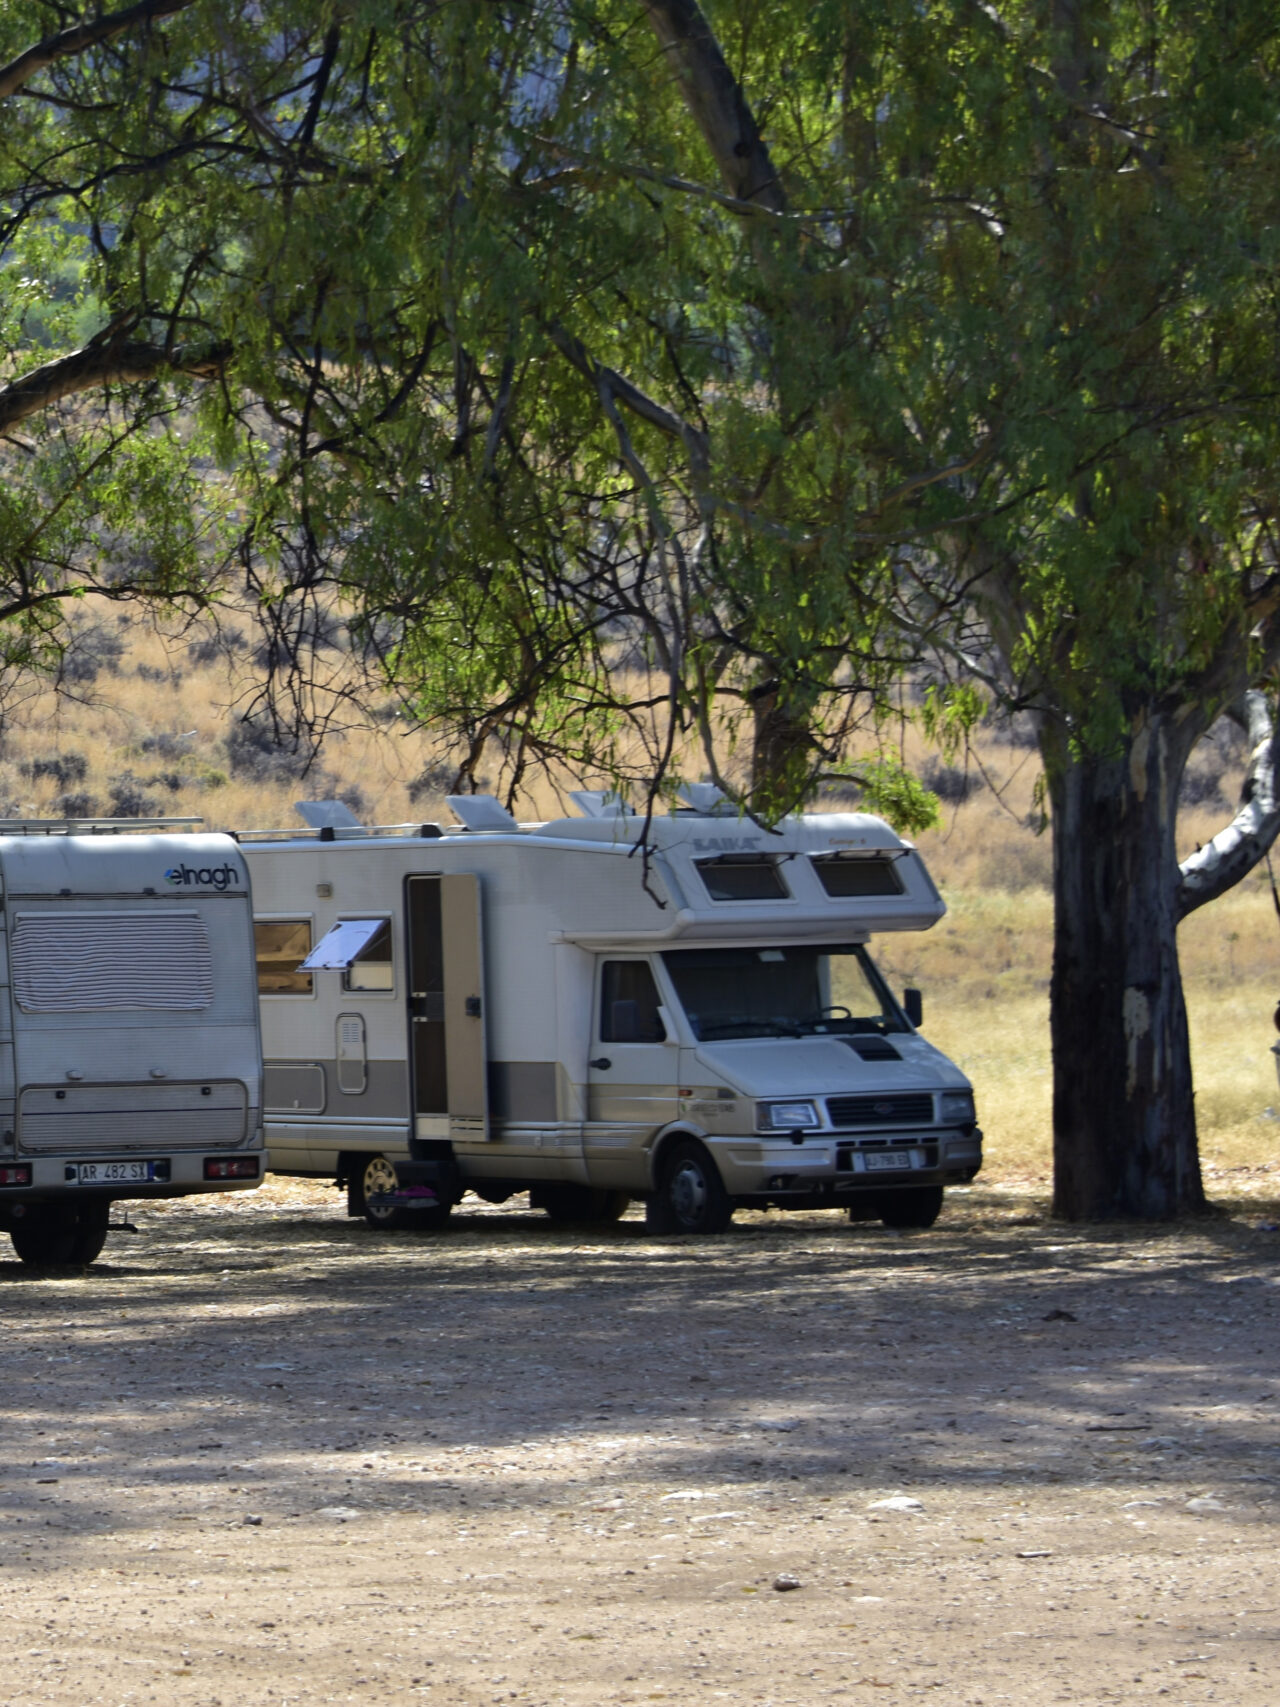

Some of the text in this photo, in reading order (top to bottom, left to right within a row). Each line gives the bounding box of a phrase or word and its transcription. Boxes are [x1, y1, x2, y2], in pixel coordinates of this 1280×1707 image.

[693, 837, 761, 851] LAIKA
[164, 863, 239, 891] elnagh
[82, 1163, 146, 1180] AR 482 SX
